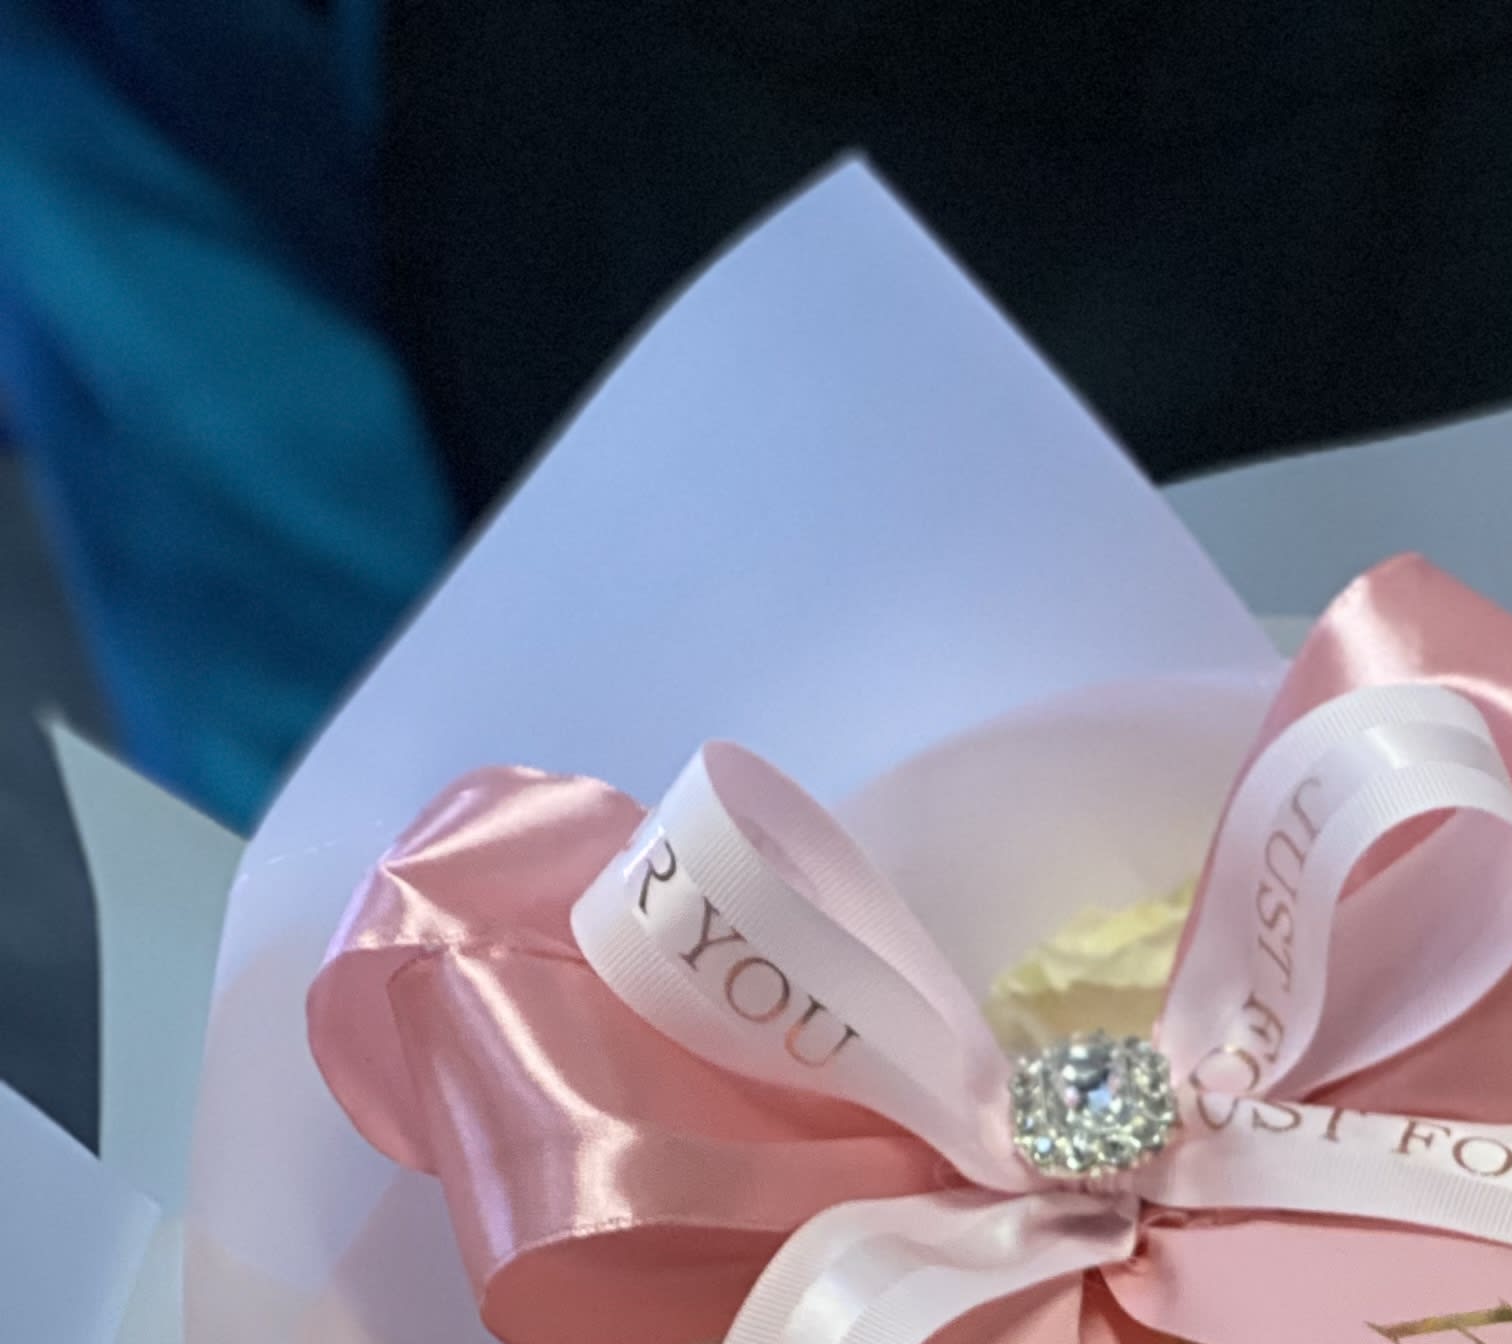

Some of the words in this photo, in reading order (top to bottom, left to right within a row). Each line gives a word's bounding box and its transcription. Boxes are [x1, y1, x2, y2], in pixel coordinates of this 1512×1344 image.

[1255, 775, 1325, 993] JUST
[678, 895, 861, 1068] YOU
[1188, 989, 1286, 1094] FO
[1196, 1096, 1366, 1142] UST
